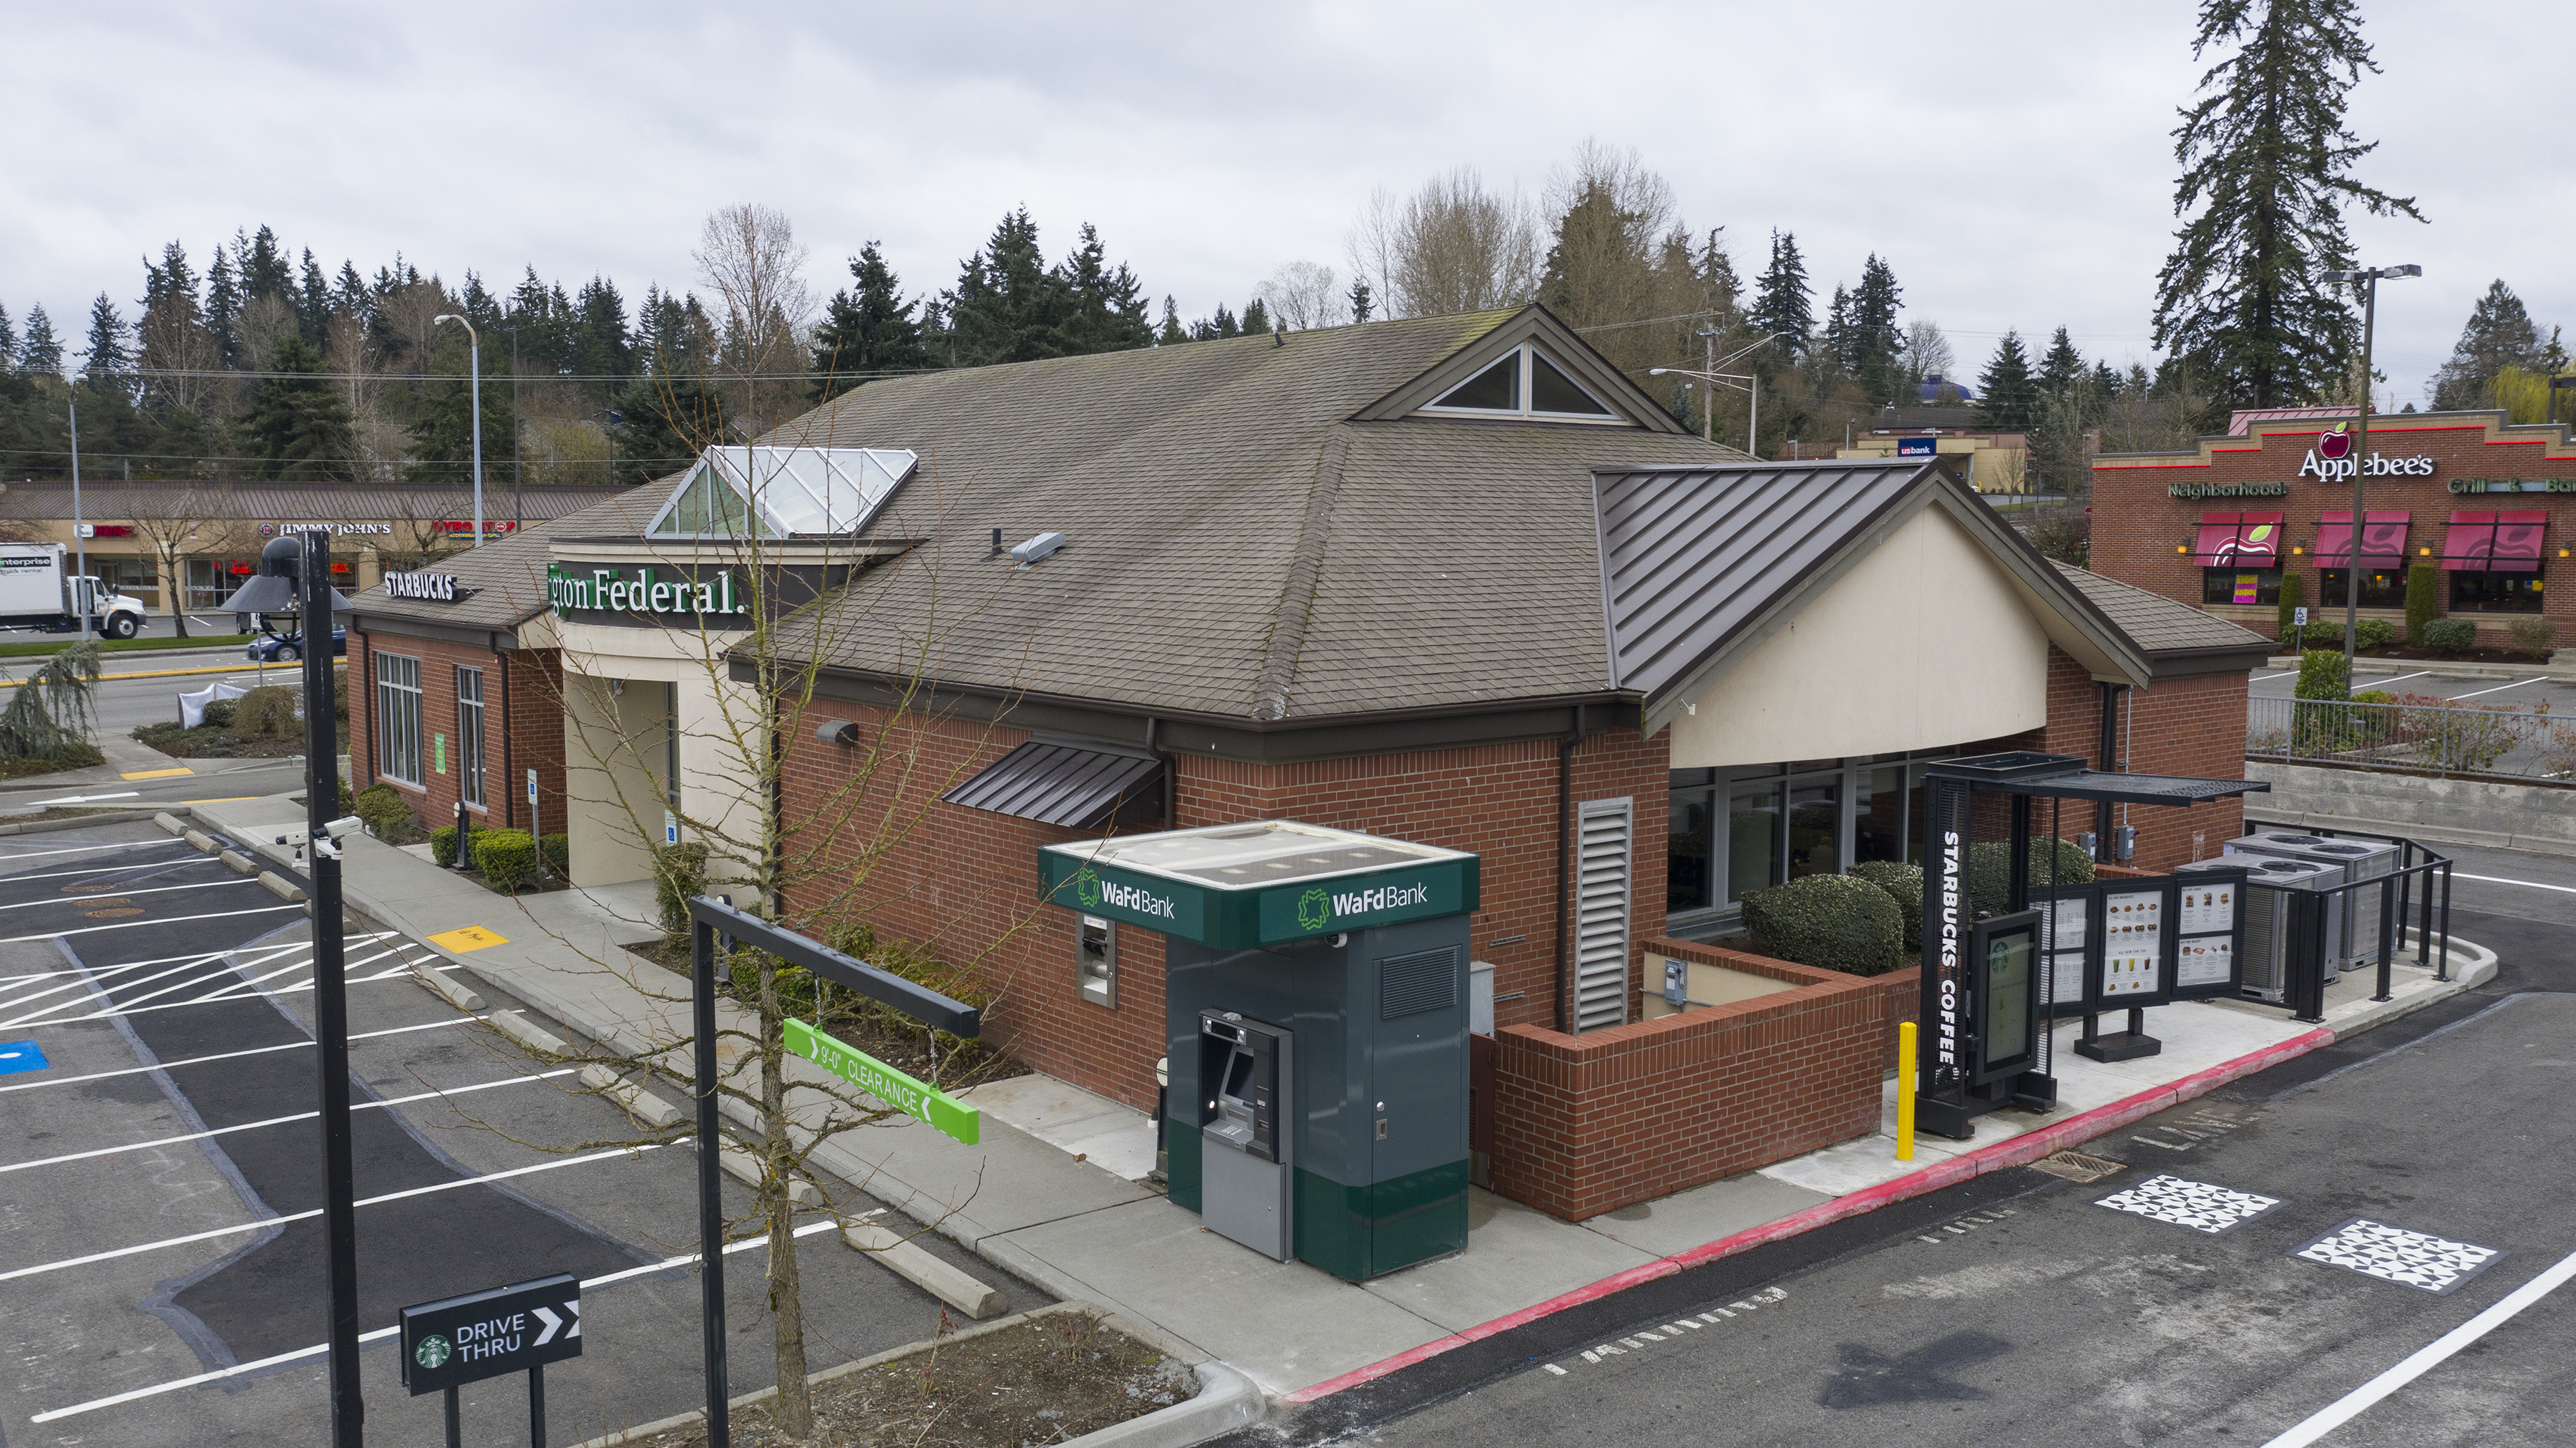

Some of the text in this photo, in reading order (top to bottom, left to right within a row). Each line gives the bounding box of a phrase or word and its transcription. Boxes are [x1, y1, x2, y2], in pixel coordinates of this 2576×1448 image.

[2298, 449, 2434, 482] Applebee's
[2168, 482, 2284, 500] Neighborhood
[2447, 477, 2487, 494] Grill
[2508, 477, 2521, 492] &
[337, 524, 391, 536] JOHN'S
[433, 521, 473, 531] GYRO
[384, 571, 454, 601] STARBUCKS
[593, 568, 745, 614] Federal.
[1101, 880, 1175, 920] WaFd Bank
[1333, 882, 1428, 917] WaFd Bank
[1939, 831, 1959, 1065] STARBUCKS COFFEE
[848, 1059, 917, 1112] CLEARANCE
[457, 1313, 525, 1344] DRIVE
[458, 1333, 521, 1363] THRU
